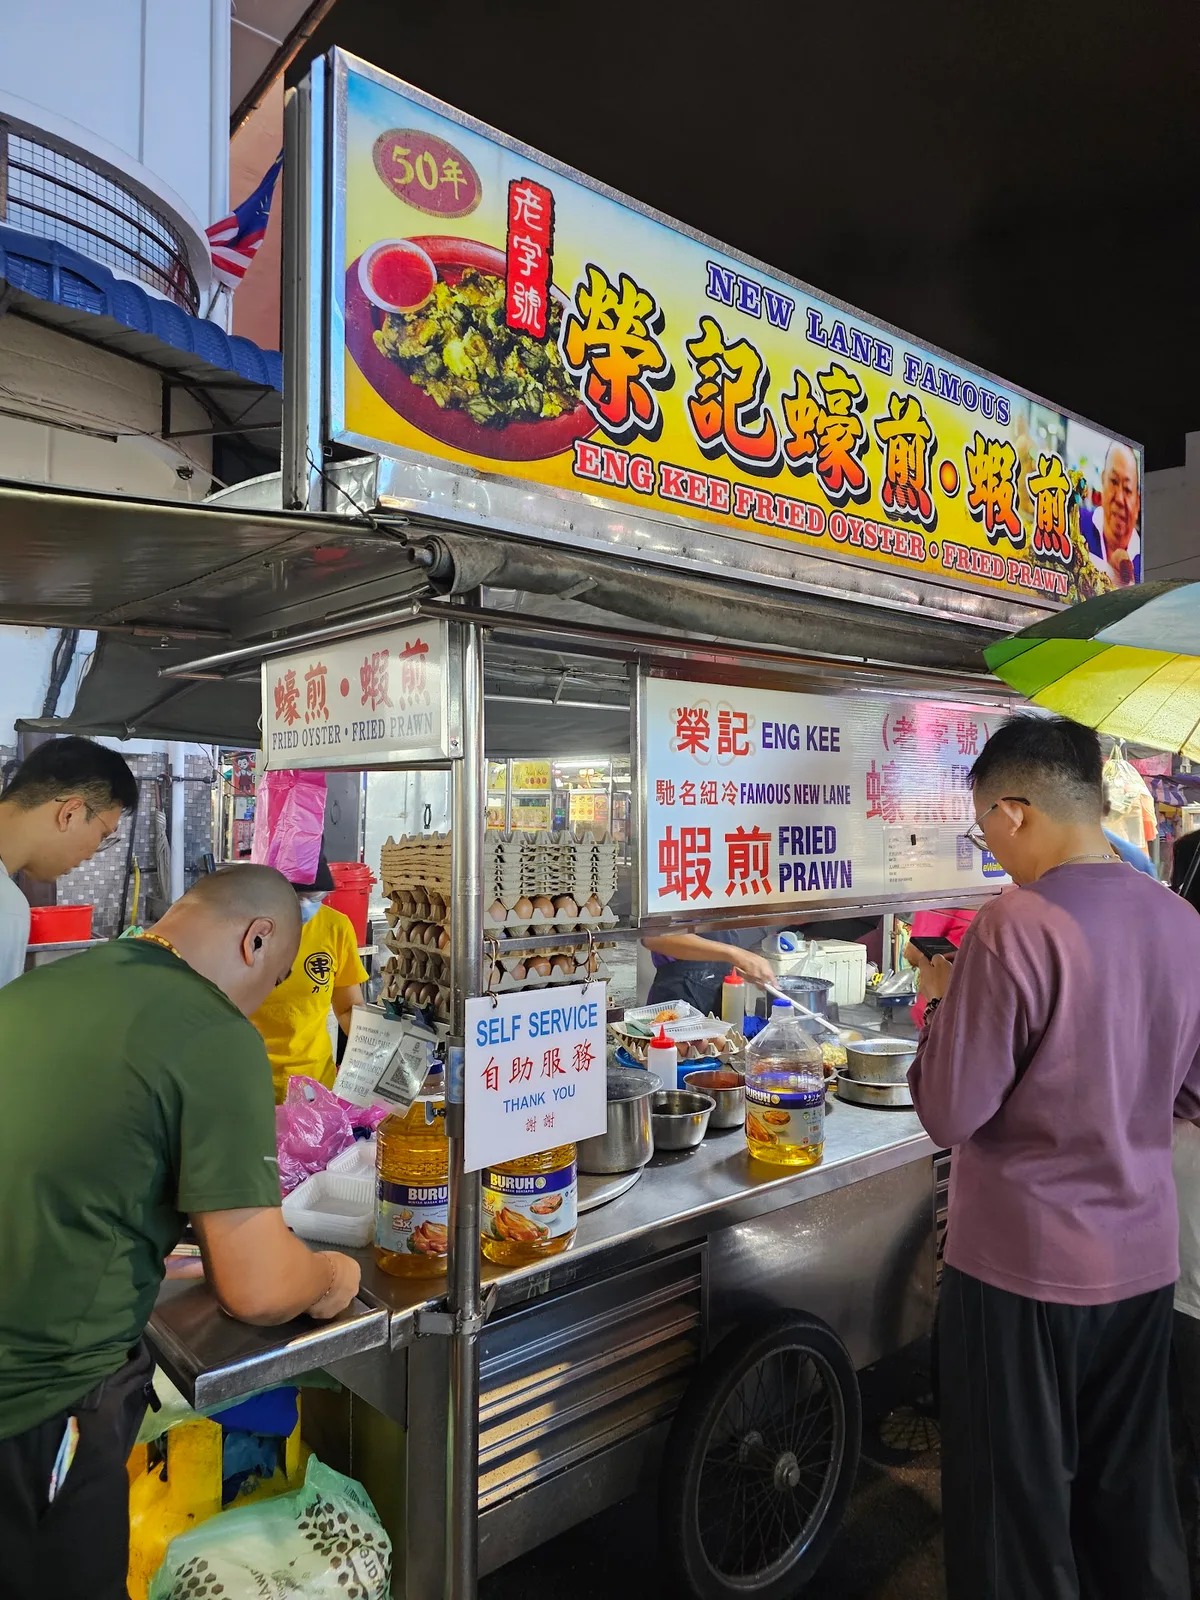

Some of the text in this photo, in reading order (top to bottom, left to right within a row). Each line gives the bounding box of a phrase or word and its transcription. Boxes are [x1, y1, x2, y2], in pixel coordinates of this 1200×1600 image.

[391, 145, 469, 200] 50年
[511, 187, 544, 331] 老字號
[707, 262, 1011, 425] NEW LANE FAMOUS
[575, 441, 1069, 597] ENG KEE FRIED OYSTER FRIED PRAWN
[272, 712, 433, 750] FRIED OYSTER FRIED PRAWN
[676, 706, 750, 756] 榮記
[762, 721, 841, 752] ENG KEE
[656, 779, 739, 806] 馳名紐冷
[740, 782, 851, 805] FAMOUS NEW LANE
[778, 825, 837, 856] FRIED
[658, 824, 773, 902] 蝦煎
[779, 860, 853, 893] PRAWN
[476, 1002, 598, 1047] SELF SERVICE
[480, 1038, 597, 1092] 自助服務
[503, 1084, 576, 1114] THANK YOU
[525, 1111, 555, 1133] 謝謝
[408, 1187, 448, 1201] BURU
[490, 1172, 535, 1190] BURUH
